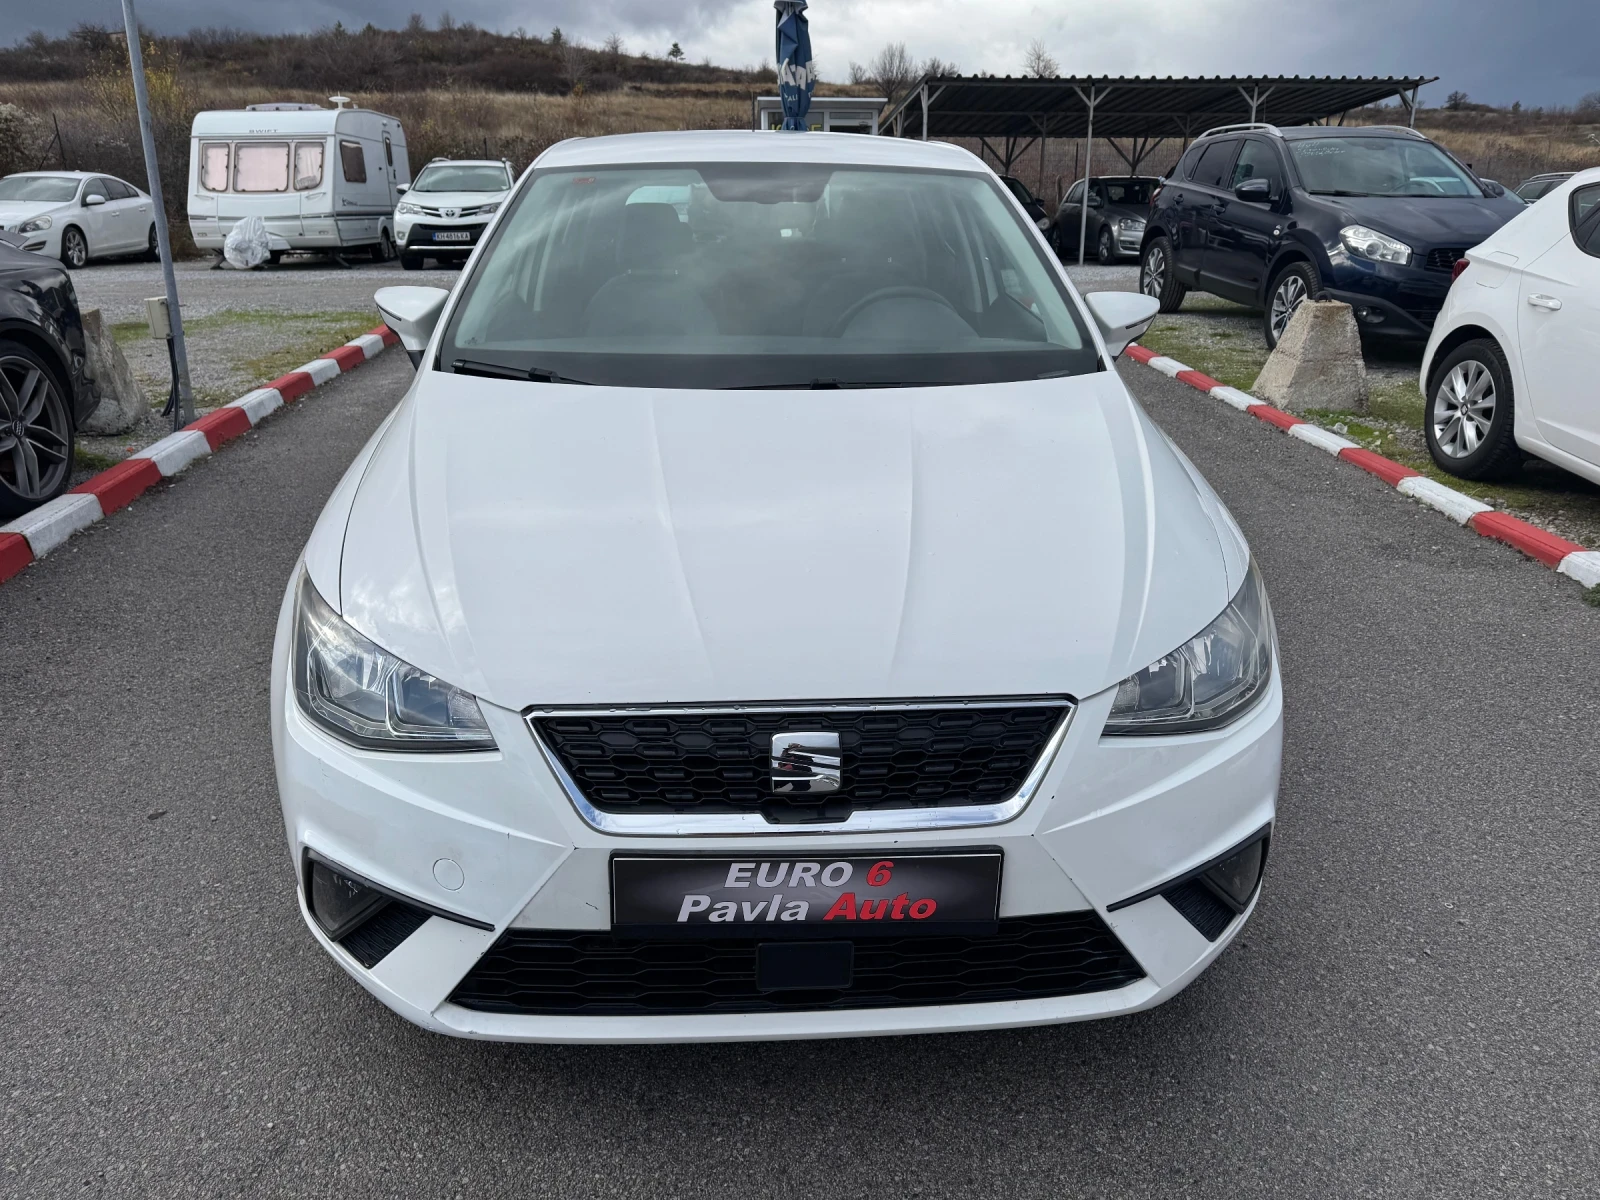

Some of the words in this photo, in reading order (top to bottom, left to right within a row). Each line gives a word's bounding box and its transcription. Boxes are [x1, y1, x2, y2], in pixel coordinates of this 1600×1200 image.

[723, 861, 854, 888] EURO
[866, 860, 894, 886] 6
[676, 894, 810, 922] Pavla
[823, 892, 937, 920] Auto
